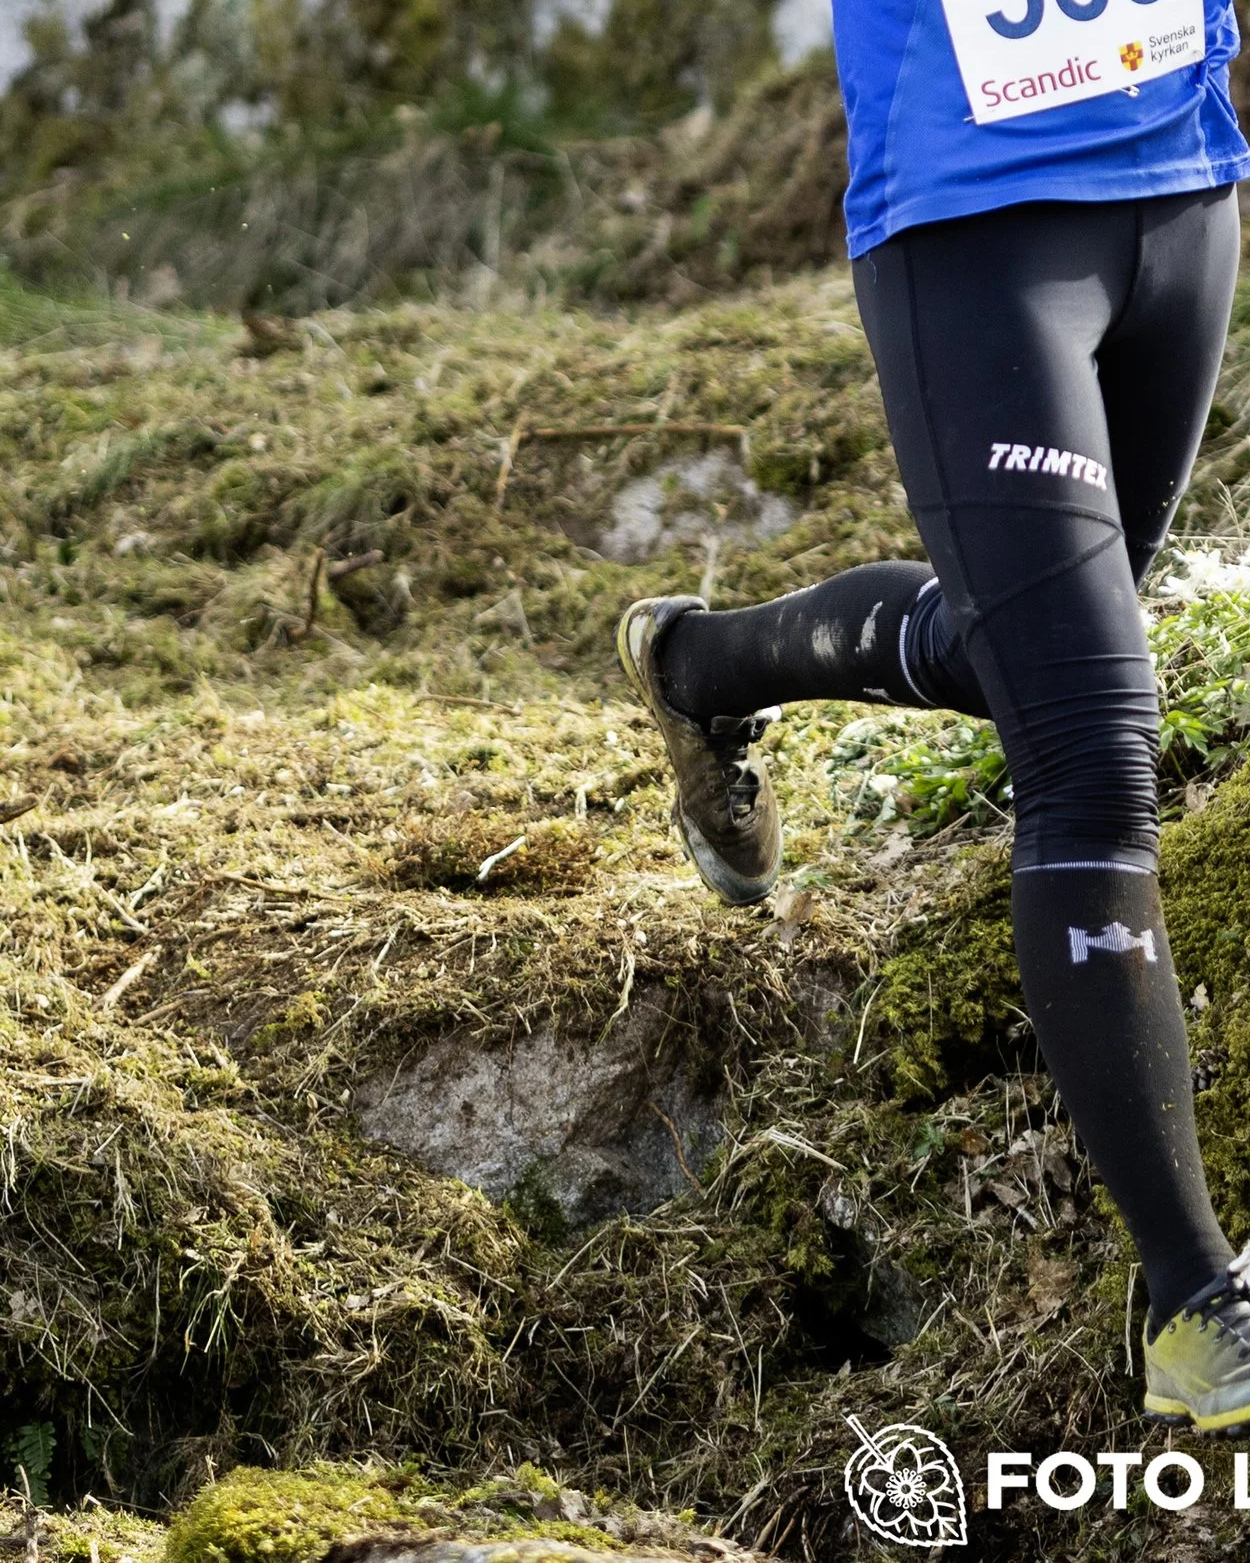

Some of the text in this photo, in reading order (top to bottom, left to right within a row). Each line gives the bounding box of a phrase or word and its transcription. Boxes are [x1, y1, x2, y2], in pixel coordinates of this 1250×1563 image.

[1148, 24, 1196, 48] Svenska
[1150, 41, 1189, 63] kyrkan
[980, 55, 1102, 108] Scandic
[987, 442, 1108, 491] TRIMTEX
